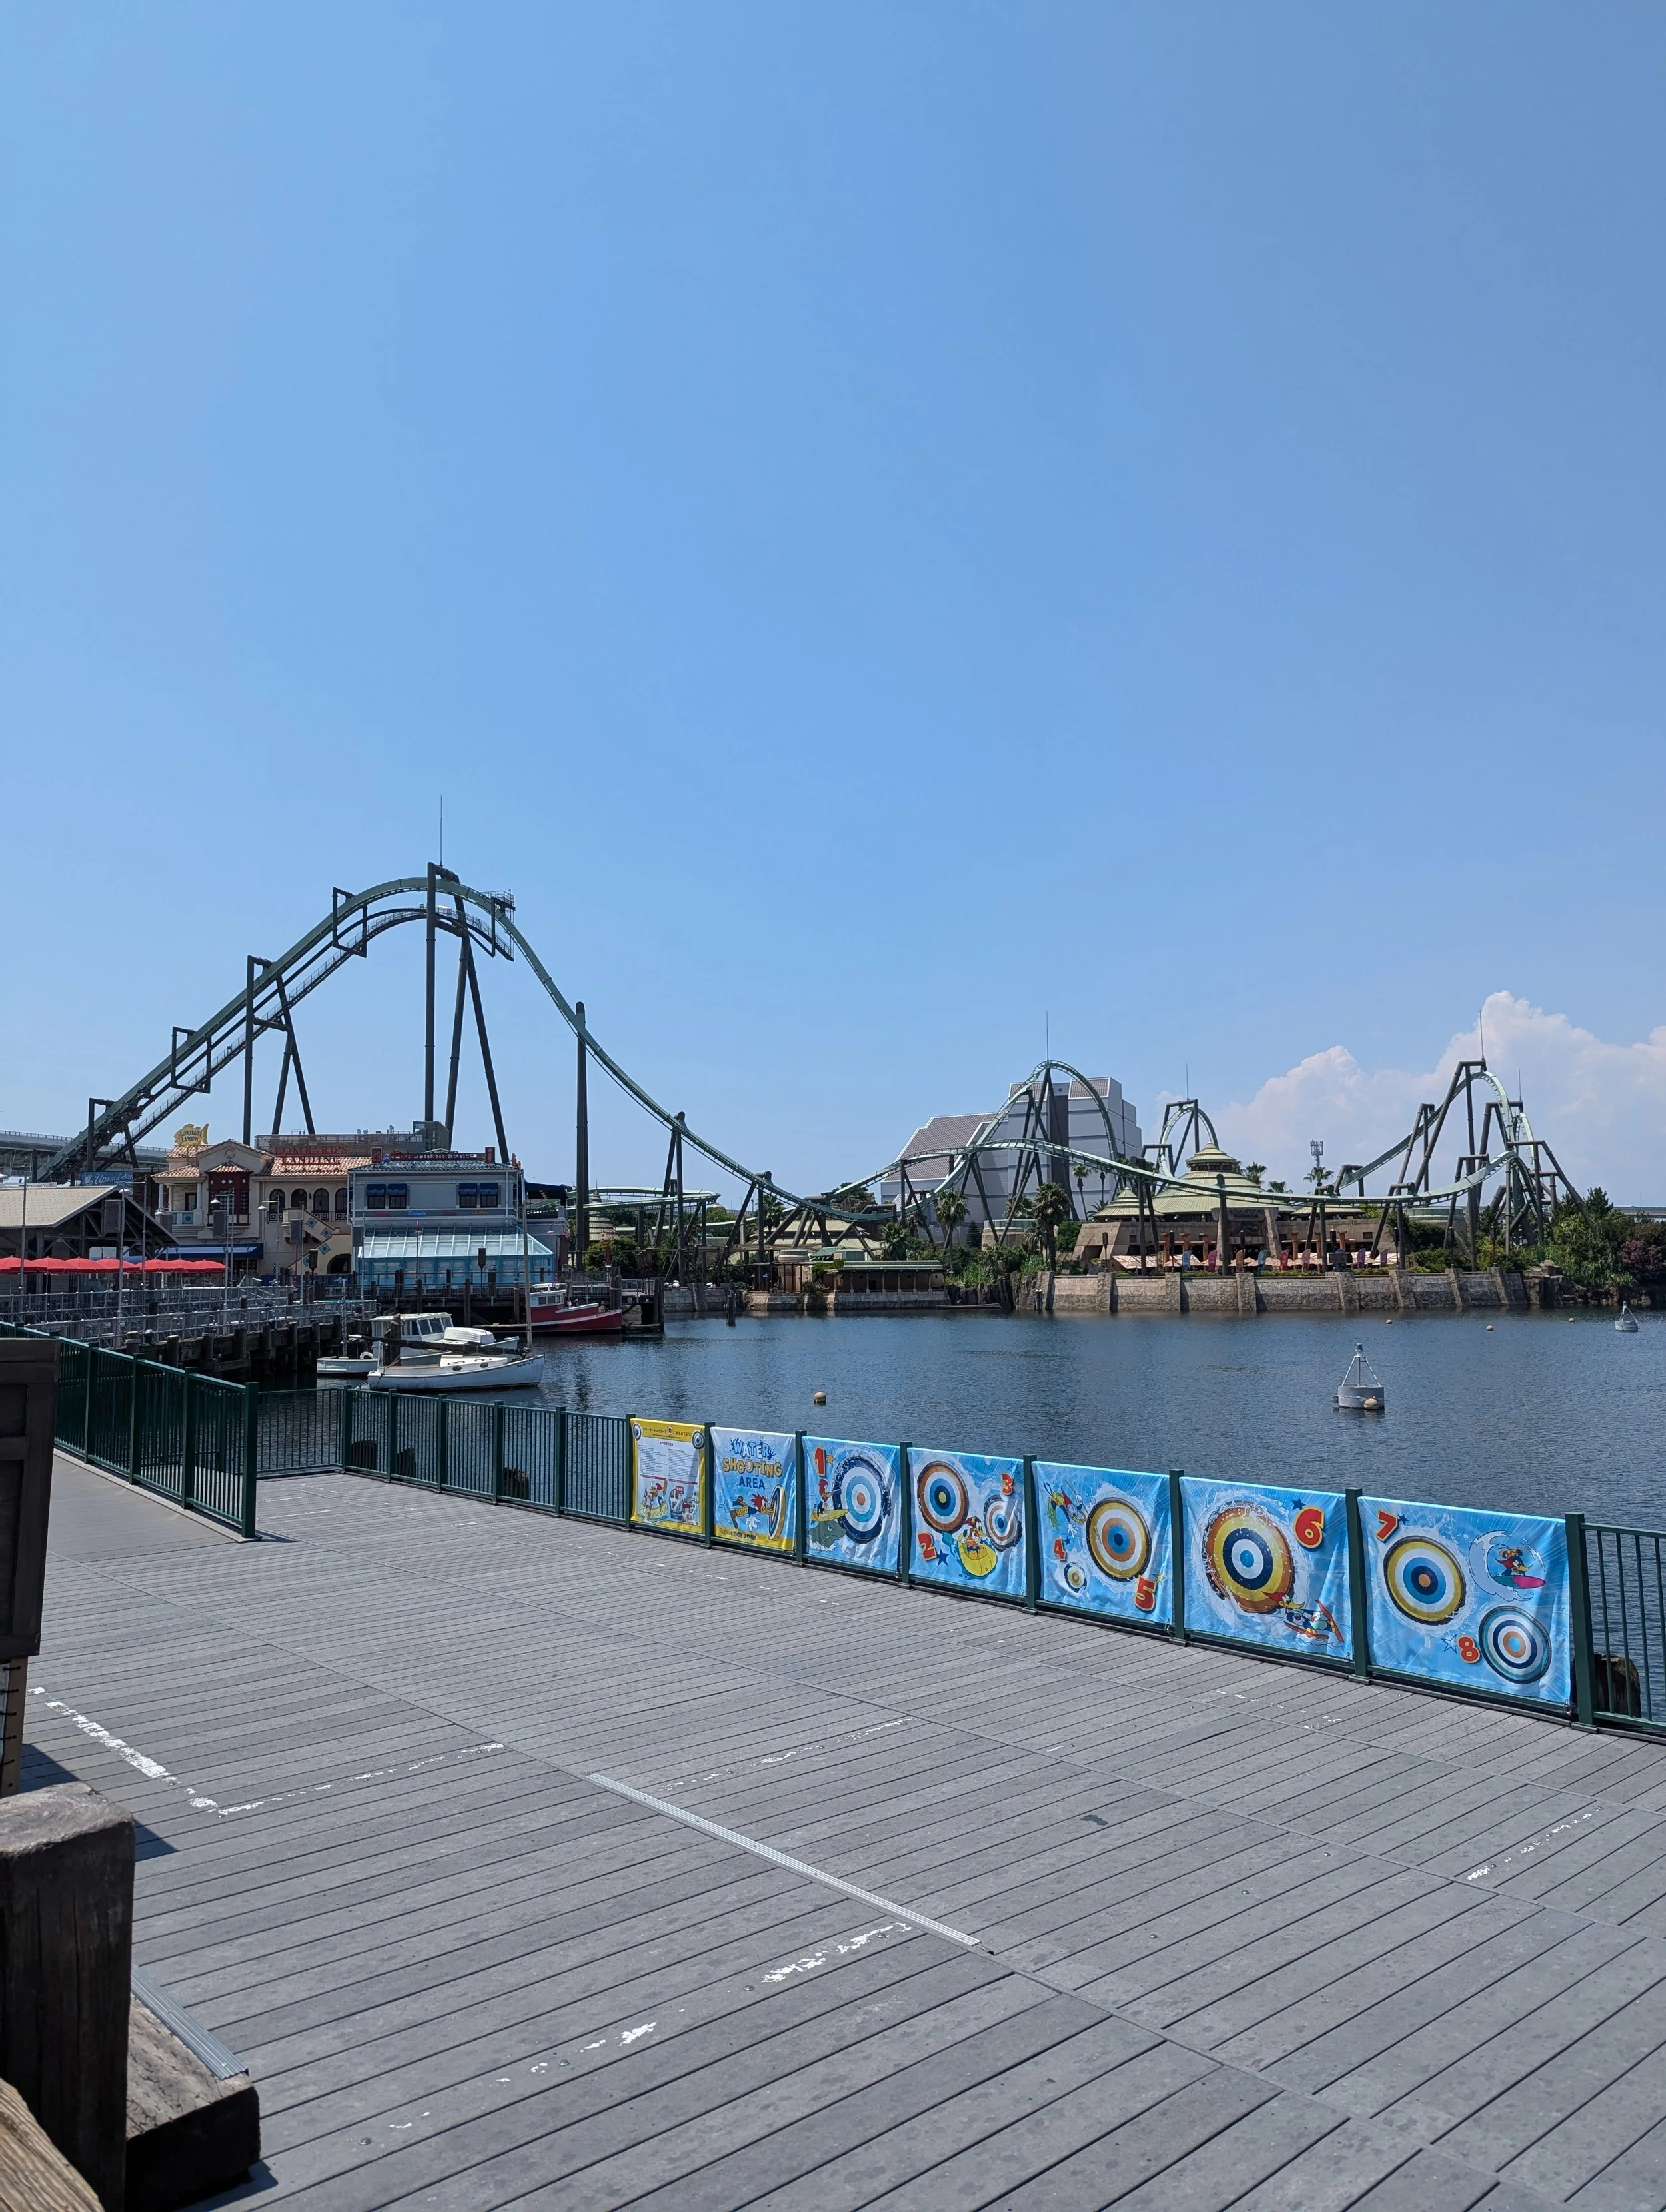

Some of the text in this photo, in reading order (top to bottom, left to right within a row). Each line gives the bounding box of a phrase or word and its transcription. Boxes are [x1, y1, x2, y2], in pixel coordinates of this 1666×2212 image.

[275, 1145, 347, 1155] LOMBARD'S
[733, 1439, 770, 1460] WATER
[814, 1446, 826, 1477] 1
[722, 1457, 783, 1478] SHOOTING
[738, 1476, 766, 1490] AREA
[1002, 1474, 1014, 1496] 3
[1293, 1506, 1325, 1549] 6
[1376, 1510, 1398, 1543] 7
[916, 1532, 938, 1562] 2
[1053, 1538, 1066, 1562] 4
[1134, 1574, 1156, 1612] 5
[1457, 1636, 1481, 1664] 8
